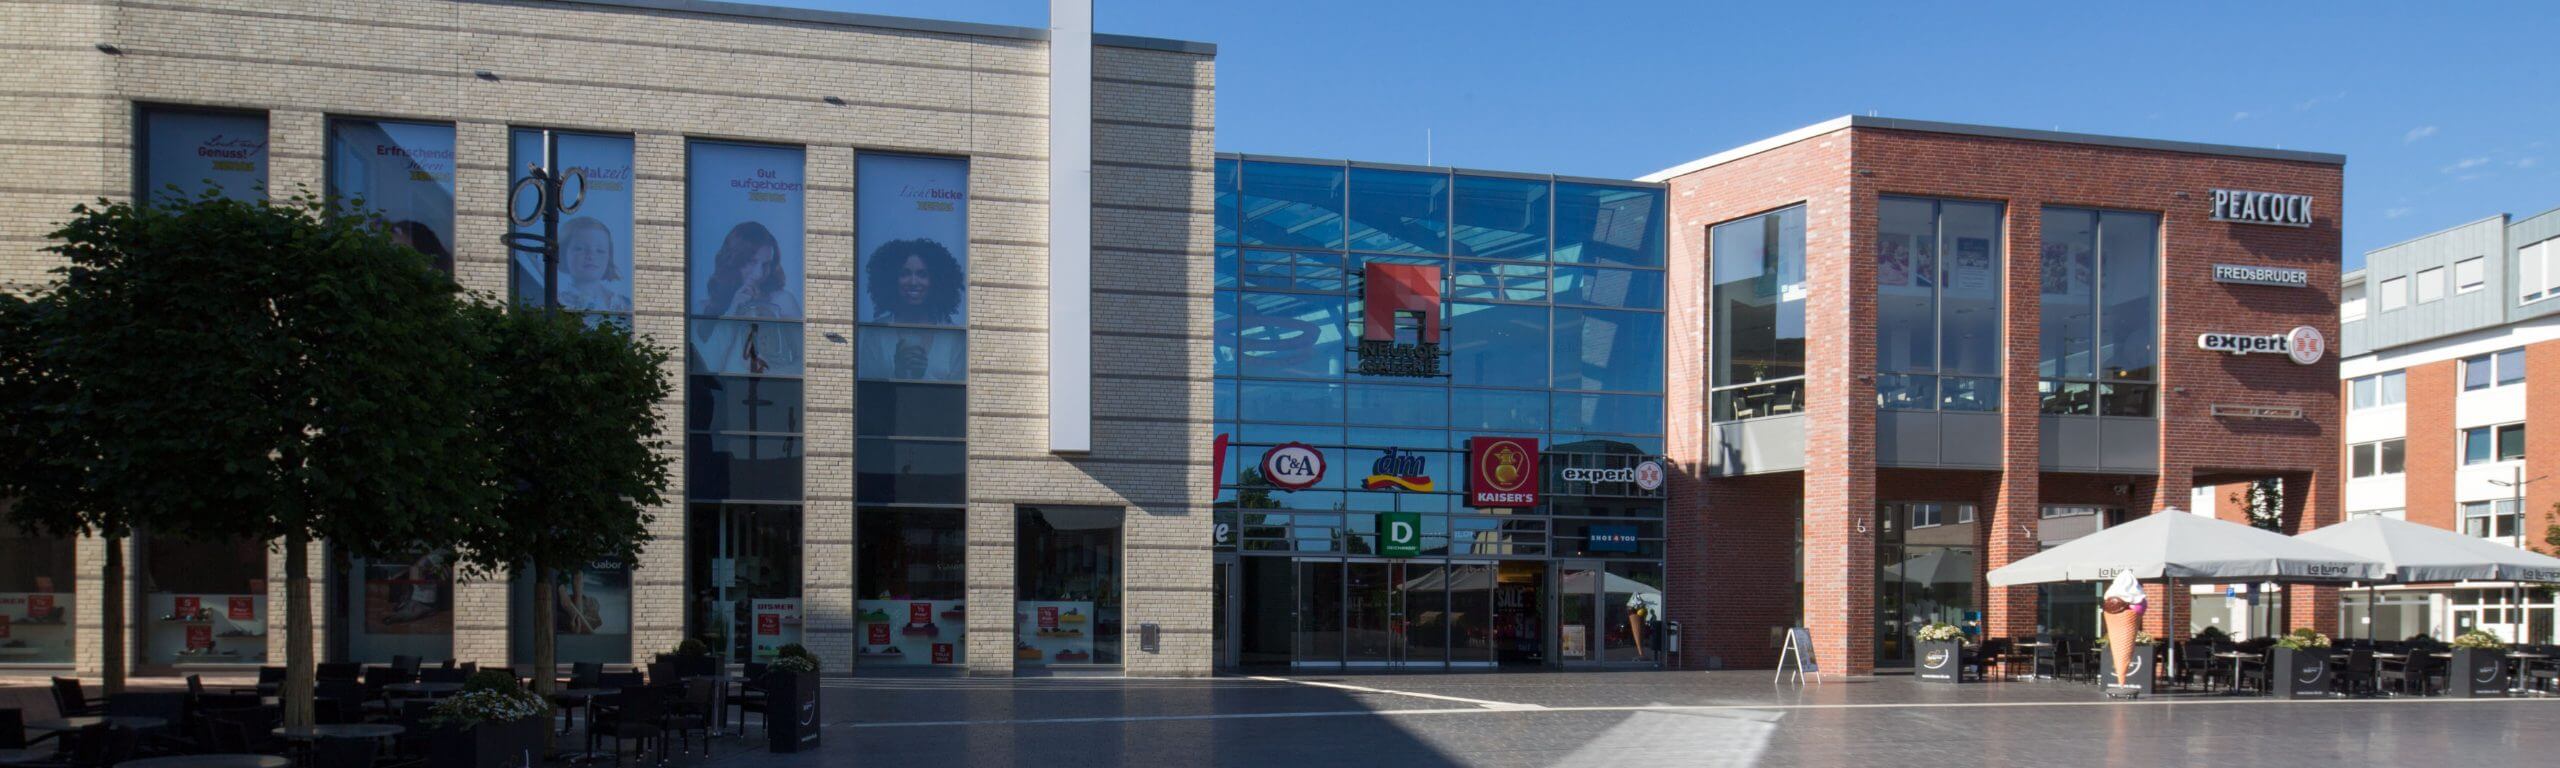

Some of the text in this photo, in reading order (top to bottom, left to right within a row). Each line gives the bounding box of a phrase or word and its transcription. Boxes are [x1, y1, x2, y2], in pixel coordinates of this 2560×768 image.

[198, 146, 247, 159] Genuss!
[757, 168, 777, 179] Gut
[730, 177, 803, 192] aufgehoben
[2214, 189, 2314, 224] PEACOCK
[2216, 266, 2307, 284] FREDsBRUDER
[2204, 334, 2288, 352] expert
[1275, 454, 1316, 477] C&A
[1377, 447, 1426, 477] dm
[1563, 468, 1635, 483] expert
[1478, 492, 1533, 503] KAISER'S
[1391, 521, 1413, 543] D
[592, 560, 623, 569] Gabor
[1497, 586, 1524, 608] SALE
